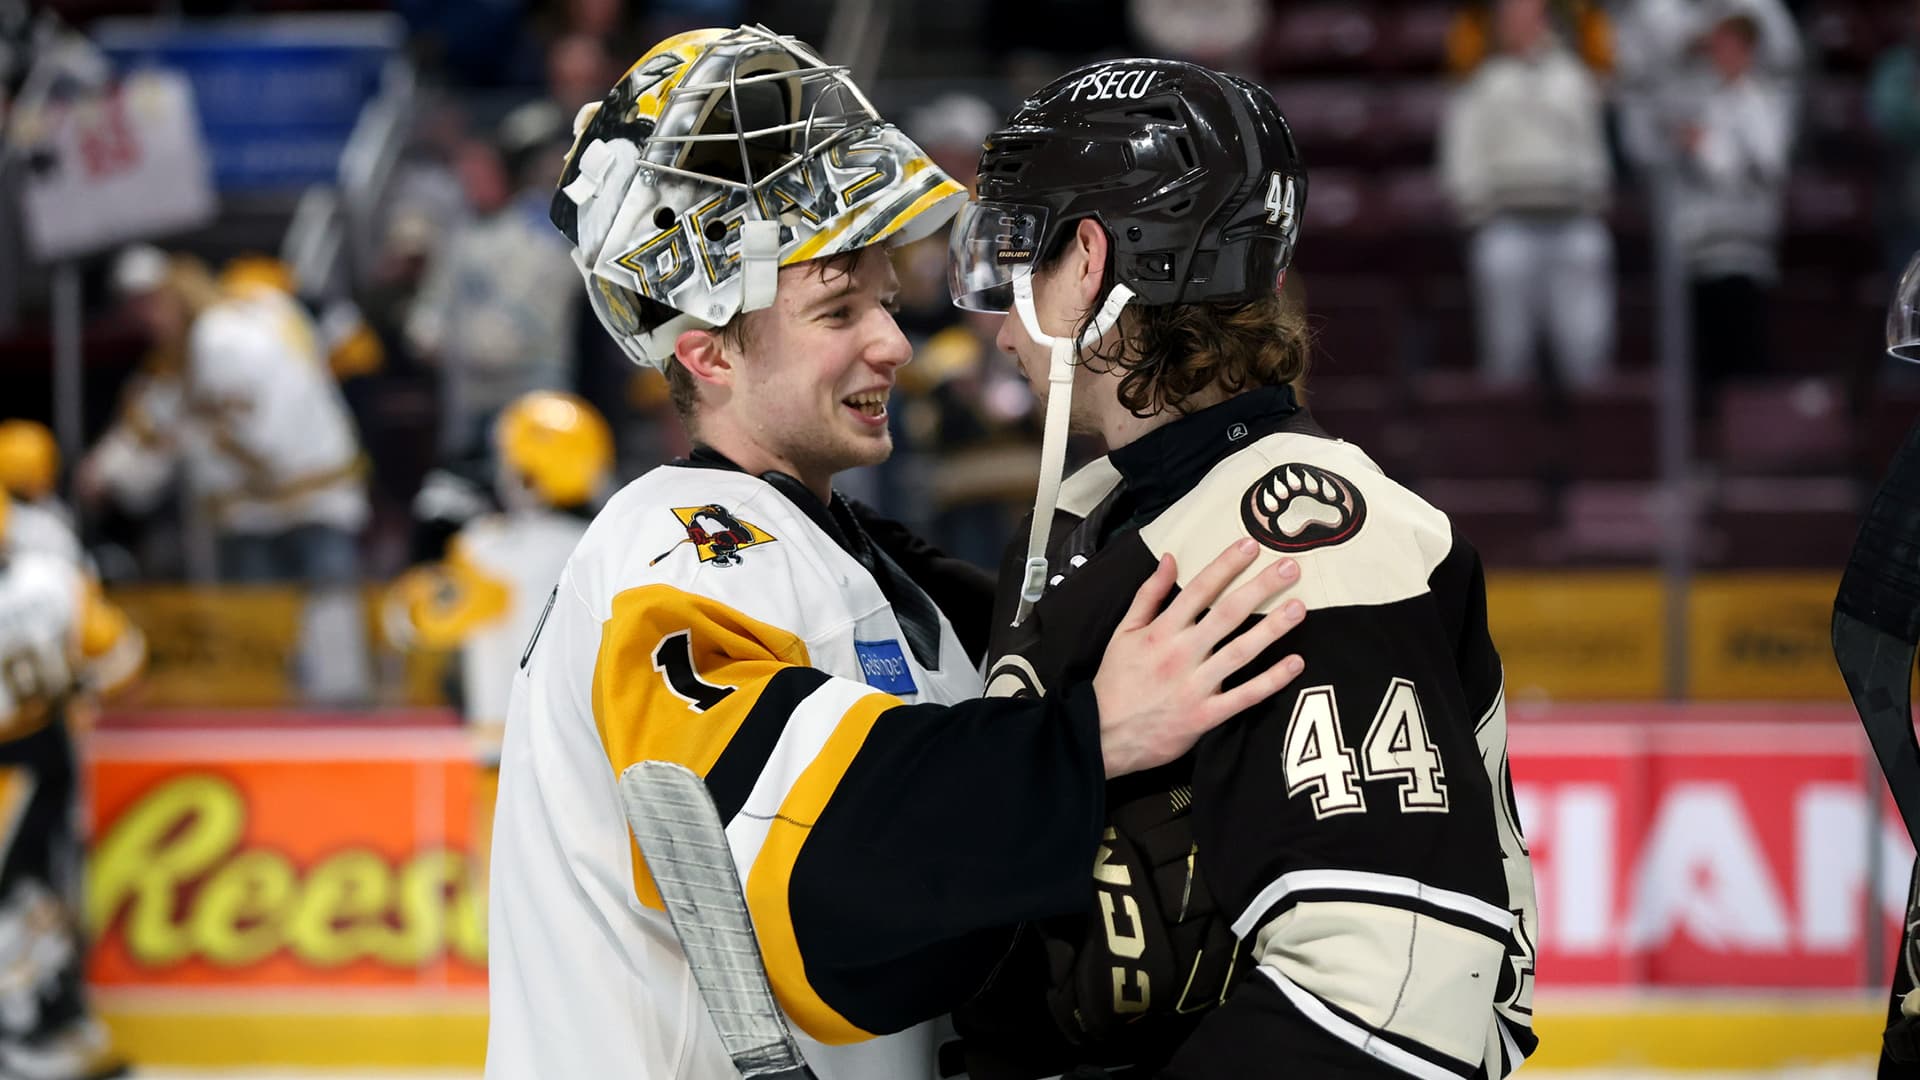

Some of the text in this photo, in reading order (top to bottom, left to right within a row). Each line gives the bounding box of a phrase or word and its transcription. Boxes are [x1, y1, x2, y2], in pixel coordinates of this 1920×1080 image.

[1070, 66, 1159, 102] PSECU
[604, 135, 903, 306] PENS
[1264, 171, 1295, 229] 44
[651, 628, 739, 713] 1
[1281, 677, 1450, 820] 44
[1093, 826, 1150, 1014] CCM
[1515, 780, 1915, 953] IAN
